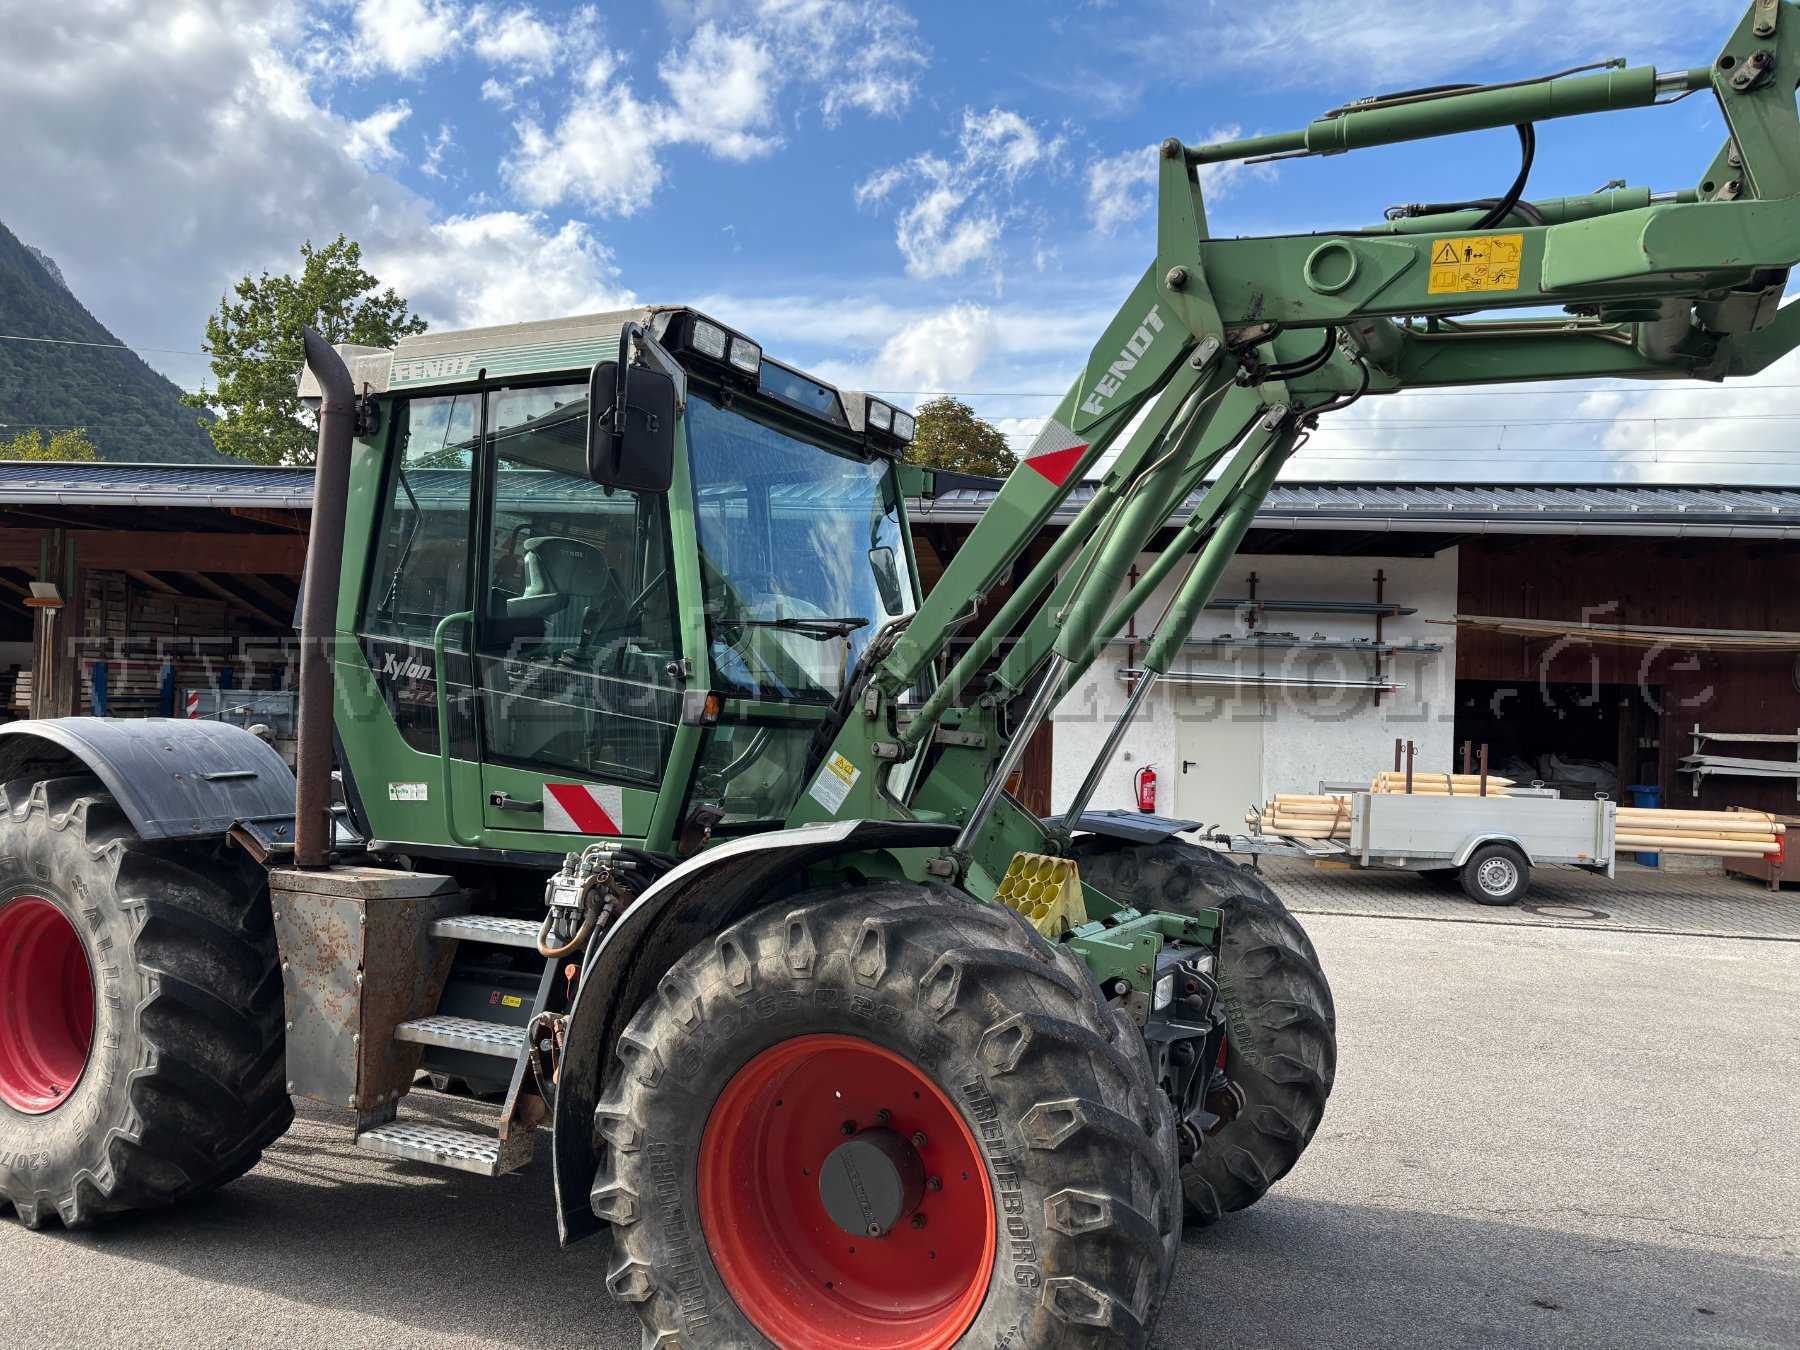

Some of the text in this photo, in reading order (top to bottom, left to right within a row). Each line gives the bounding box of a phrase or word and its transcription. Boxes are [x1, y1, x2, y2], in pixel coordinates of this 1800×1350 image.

[394, 356, 478, 380] FENDT
[1080, 303, 1164, 416] FENDT
[382, 652, 433, 681] Xylon
[962, 1073, 1041, 1289] TRELLEBORG
